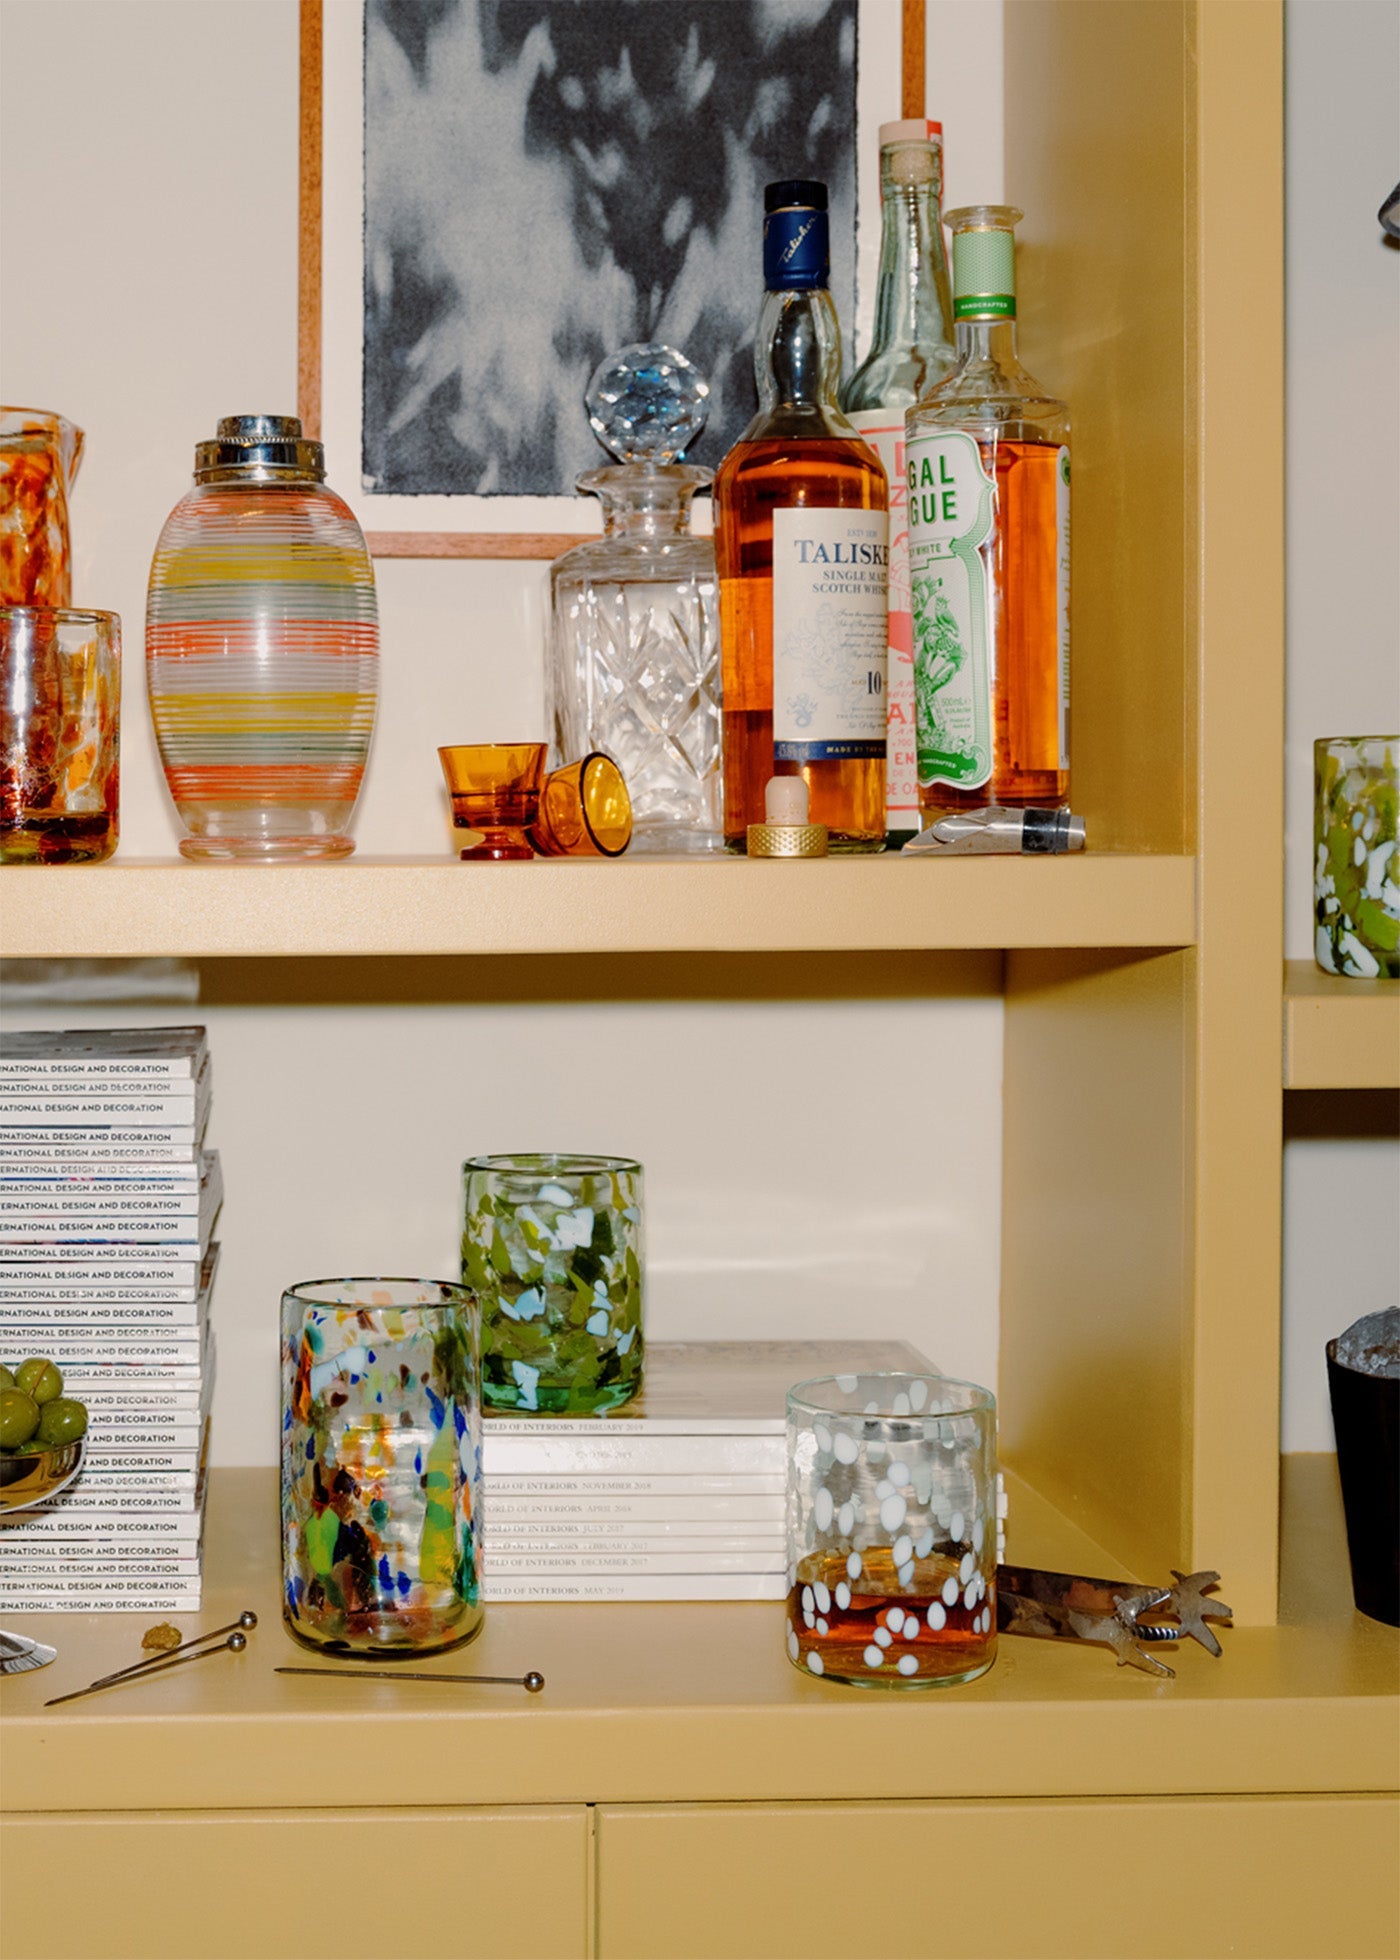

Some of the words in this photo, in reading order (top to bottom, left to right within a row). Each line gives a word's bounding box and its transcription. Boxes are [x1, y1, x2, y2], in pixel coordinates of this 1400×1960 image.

[908, 455, 955, 490] GAL
[910, 491, 957, 526] GUE
[823, 570, 866, 581] SINGLE
[812, 582, 862, 594] SCOTCH
[867, 671, 882, 694] 10
[51, 1065, 85, 1073] DESIGN
[109, 1065, 169, 1073] DECORATION
[45, 1104, 78, 1112] DESIGN
[81, 1104, 101, 1112] AND
[103, 1104, 163, 1112] DECORATION
[89, 1133, 108, 1141] AND
[111, 1133, 171, 1141] DECORATION
[54, 1149, 88, 1157] DESIGN
[91, 1149, 111, 1157] AND
[56, 1184, 89, 1192] DESIGN
[115, 1184, 174, 1192] DECORATION
[121, 1201, 181, 1209] DECORATION
[59, 1223, 93, 1231] DESIGN
[60, 1249, 93, 1257] DESIGN
[96, 1249, 116, 1257] AND
[118, 1249, 178, 1257] DECORATION
[55, 1271, 89, 1279] DESIGN
[91, 1271, 111, 1279] AND
[113, 1271, 174, 1279] DECORATION
[96, 1290, 115, 1298] AND
[118, 1290, 178, 1298] DECORATION
[54, 1309, 88, 1317] DESIGN
[113, 1309, 173, 1317] DECORATION
[58, 1329, 92, 1337] DESIGN
[59, 1347, 93, 1355] DESIGN
[96, 1347, 115, 1355] AND
[118, 1347, 179, 1355] DECORATION
[62, 1369, 90, 1377] ESIGN
[92, 1369, 112, 1377] AND
[94, 1396, 114, 1404] AND
[92, 1415, 112, 1423] AND
[115, 1415, 175, 1423] DECORATION
[112, 1458, 172, 1466] DECORATION
[94, 1477, 113, 1485] AND
[527, 1482, 578, 1490] INTERIORS
[582, 1482, 631, 1490] NOVEMBER
[62, 1498, 96, 1506] DESIGN
[58, 1523, 92, 1531] DESIGN
[117, 1523, 177, 1531] DECORATION
[59, 1547, 93, 1555] DESIGN
[118, 1547, 179, 1555] DECORATION
[60, 1565, 93, 1573] DESIGN
[68, 1582, 102, 1590] DESIGN
[105, 1582, 124, 1590] AND
[127, 1582, 187, 1590] DECORATION
